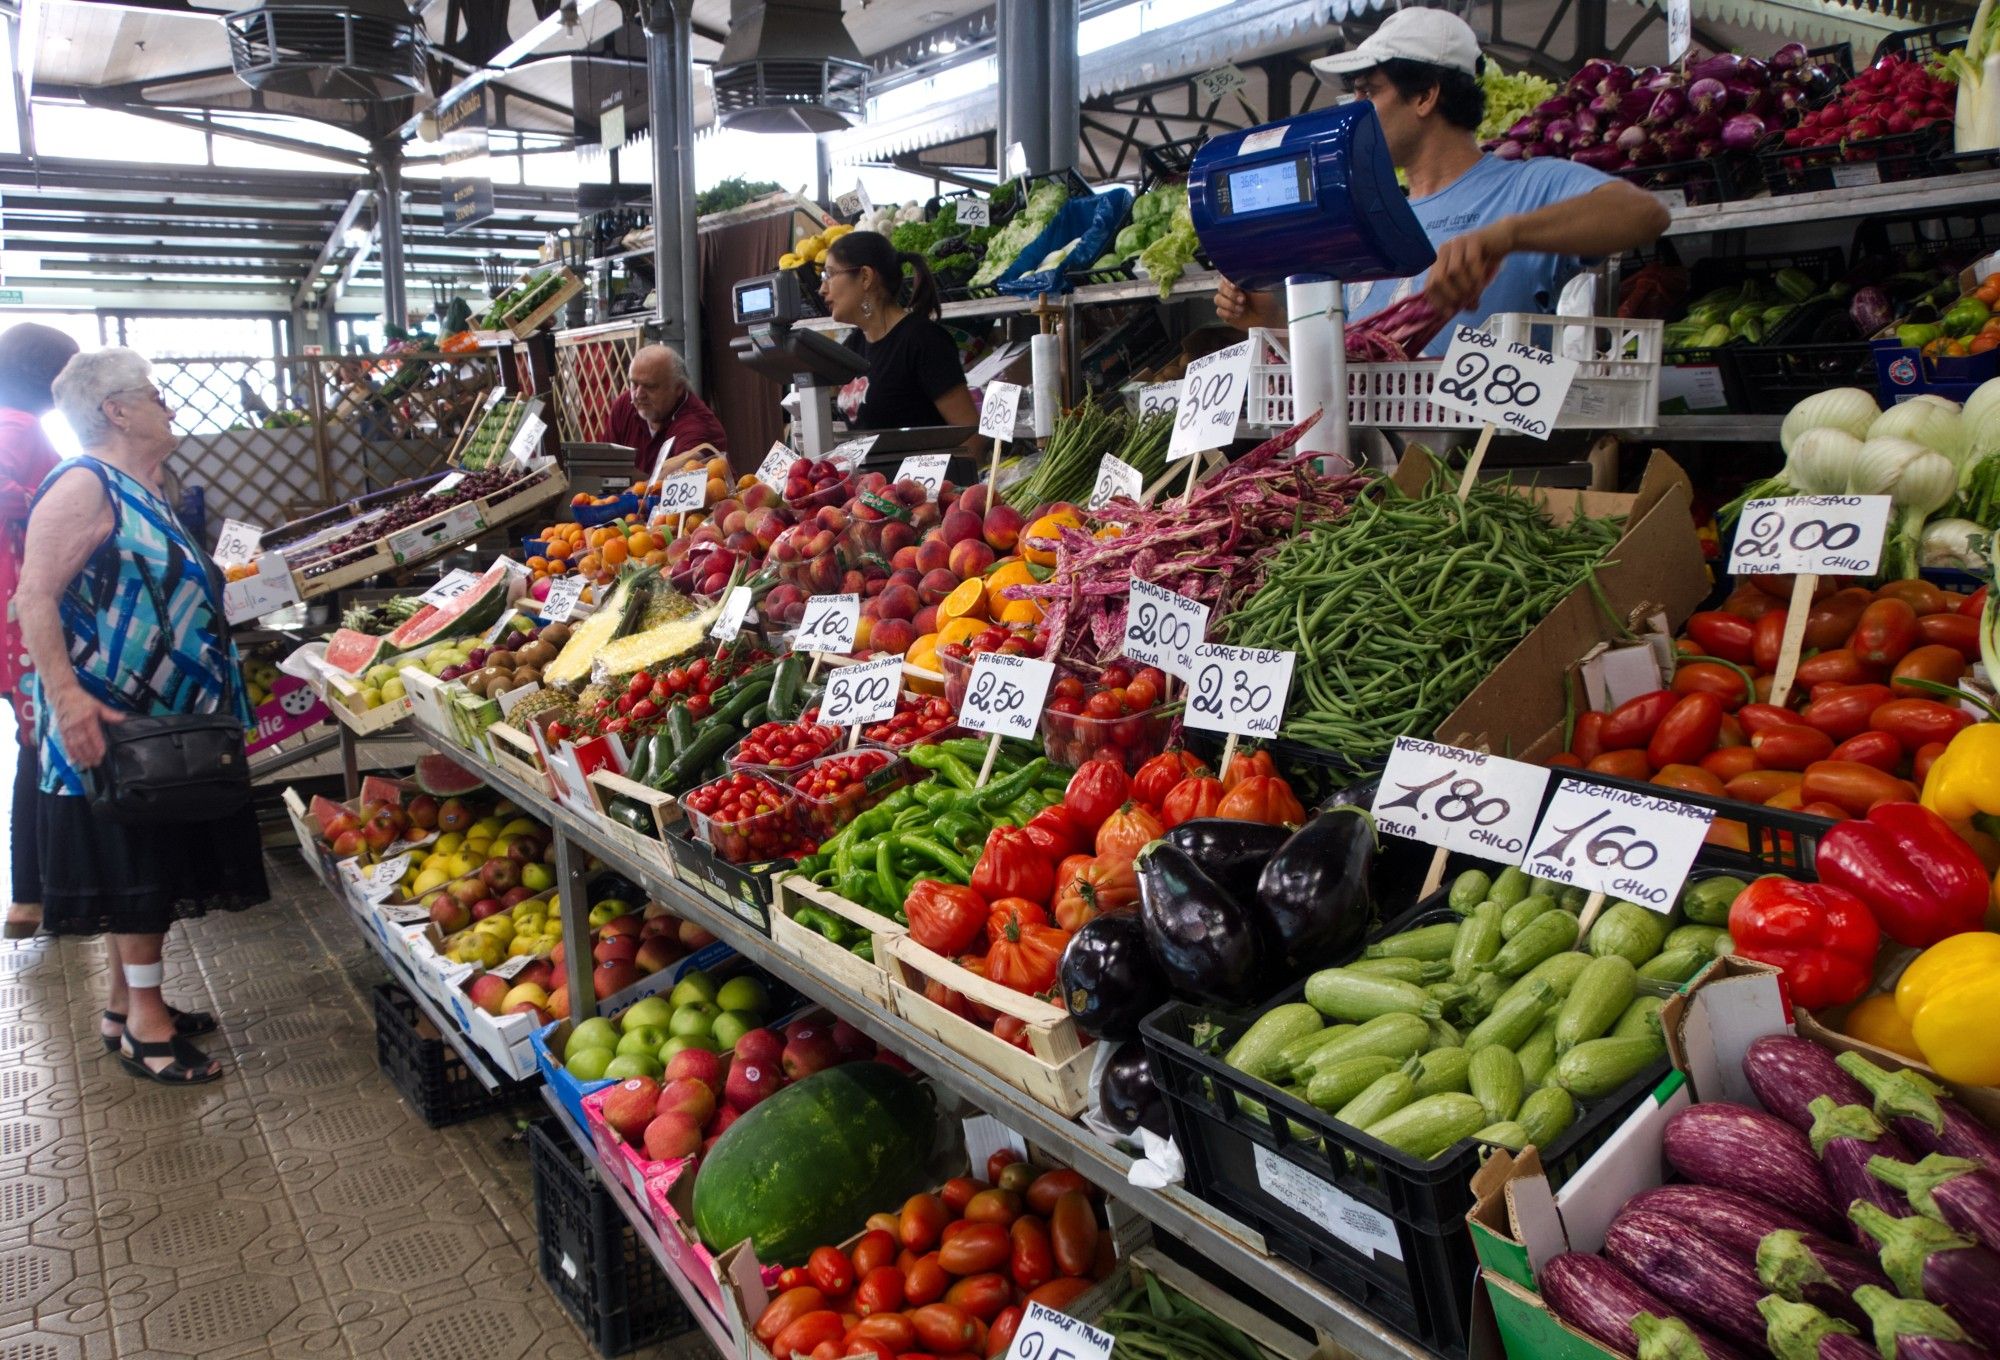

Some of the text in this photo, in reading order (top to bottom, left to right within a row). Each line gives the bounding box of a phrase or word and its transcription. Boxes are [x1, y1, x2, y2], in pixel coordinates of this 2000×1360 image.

[1426, 215, 1450, 230] surf
[1450, 212, 1481, 226] drive
[1458, 326, 1555, 366] BOBI ITALIA
[1745, 498, 1776, 511] SAN
[1737, 555, 1870, 574] ITALIA CHILO
[1131, 579, 1171, 602] CAMONE
[1127, 647, 1160, 665] ITALIA
[1194, 643, 1283, 664] CUORE DI BUE
[828, 677, 890, 717] 3,00
[1374, 817, 1524, 855] ITALIA CHILO
[1528, 862, 1669, 905] ITALIA CHILO
[1077, 1322, 1111, 1352] ITALIA
